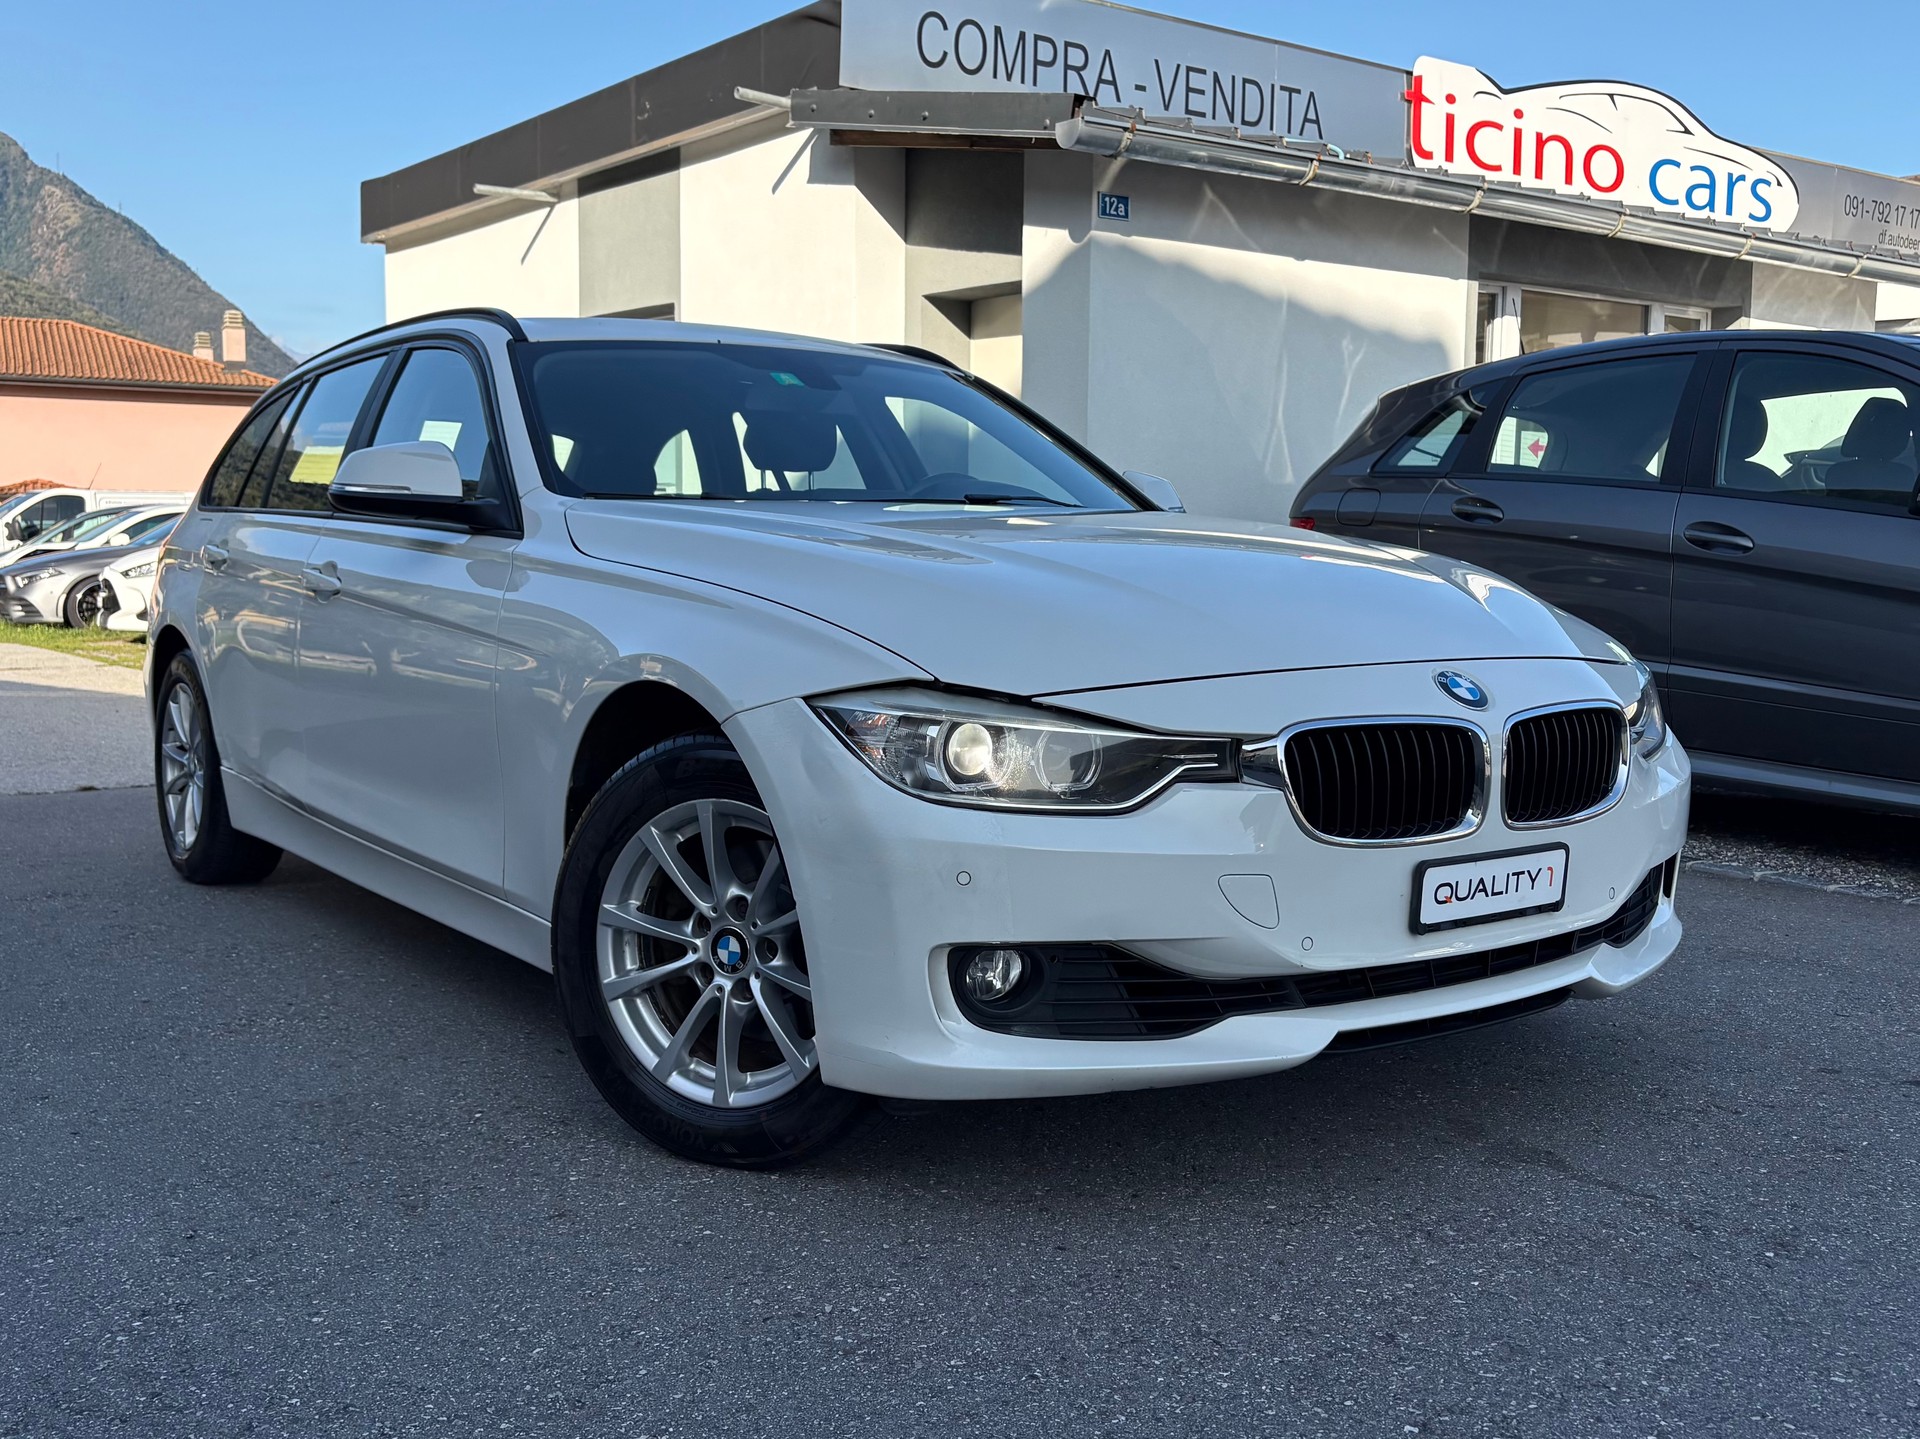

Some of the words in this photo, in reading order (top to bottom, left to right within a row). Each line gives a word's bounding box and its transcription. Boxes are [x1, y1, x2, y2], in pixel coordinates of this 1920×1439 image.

[916, 10, 1122, 104] COMPRA
[1154, 58, 1324, 140] VENDITA
[1405, 75, 1625, 193] ticino
[1648, 158, 1773, 223] cars
[1104, 196, 1126, 216] 12a
[1844, 194, 1891, 224] 091-792
[1894, 204, 1907, 227] 17
[1909, 207, 1920, 230] 17
[1433, 867, 1542, 905] QUALITY
[1547, 866, 1554, 887] 1
